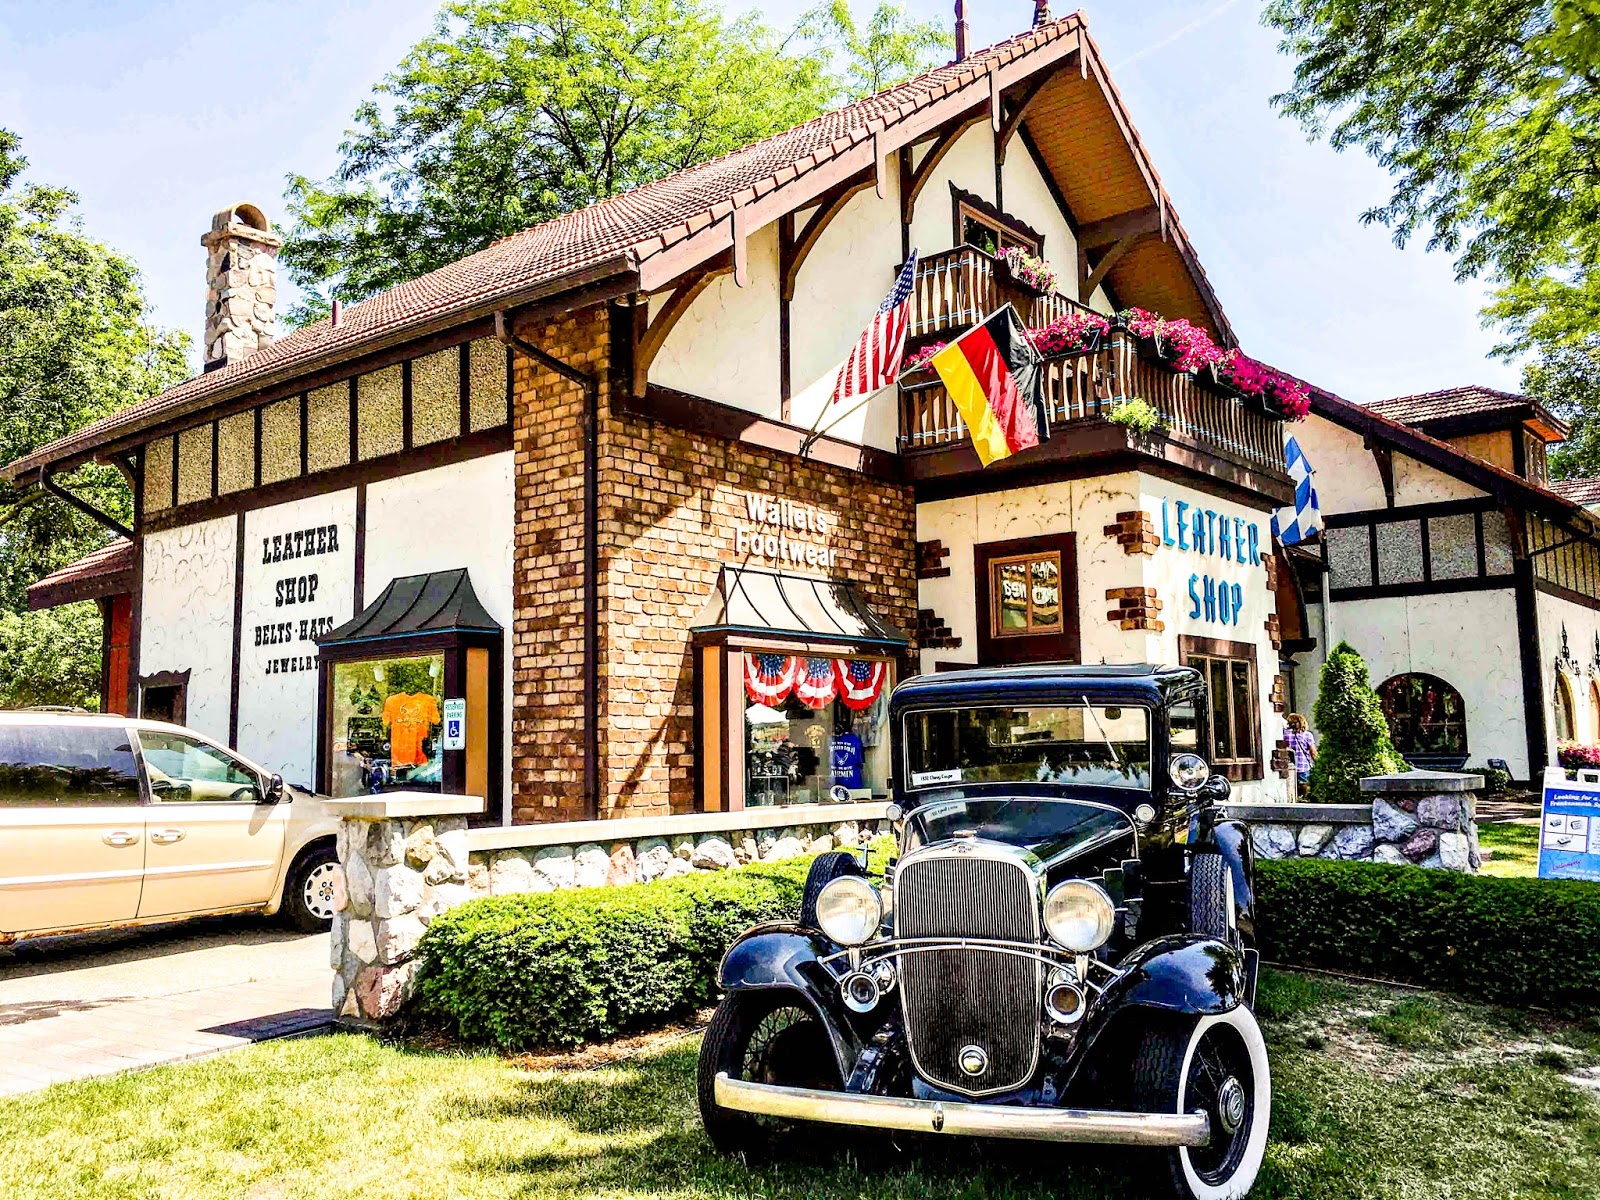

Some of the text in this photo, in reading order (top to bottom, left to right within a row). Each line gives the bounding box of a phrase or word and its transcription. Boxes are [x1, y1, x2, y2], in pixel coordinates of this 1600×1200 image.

[745, 491, 828, 533] Wallets
[1161, 496, 1261, 567] LEATHER
[262, 524, 339, 564] LEATHER
[735, 526, 837, 567] Footwear
[275, 573, 319, 608] SHOP
[1188, 572, 1243, 627] SHOP
[265, 654, 319, 675] JEWELRY
[1553, 793, 1580, 801] Looking
